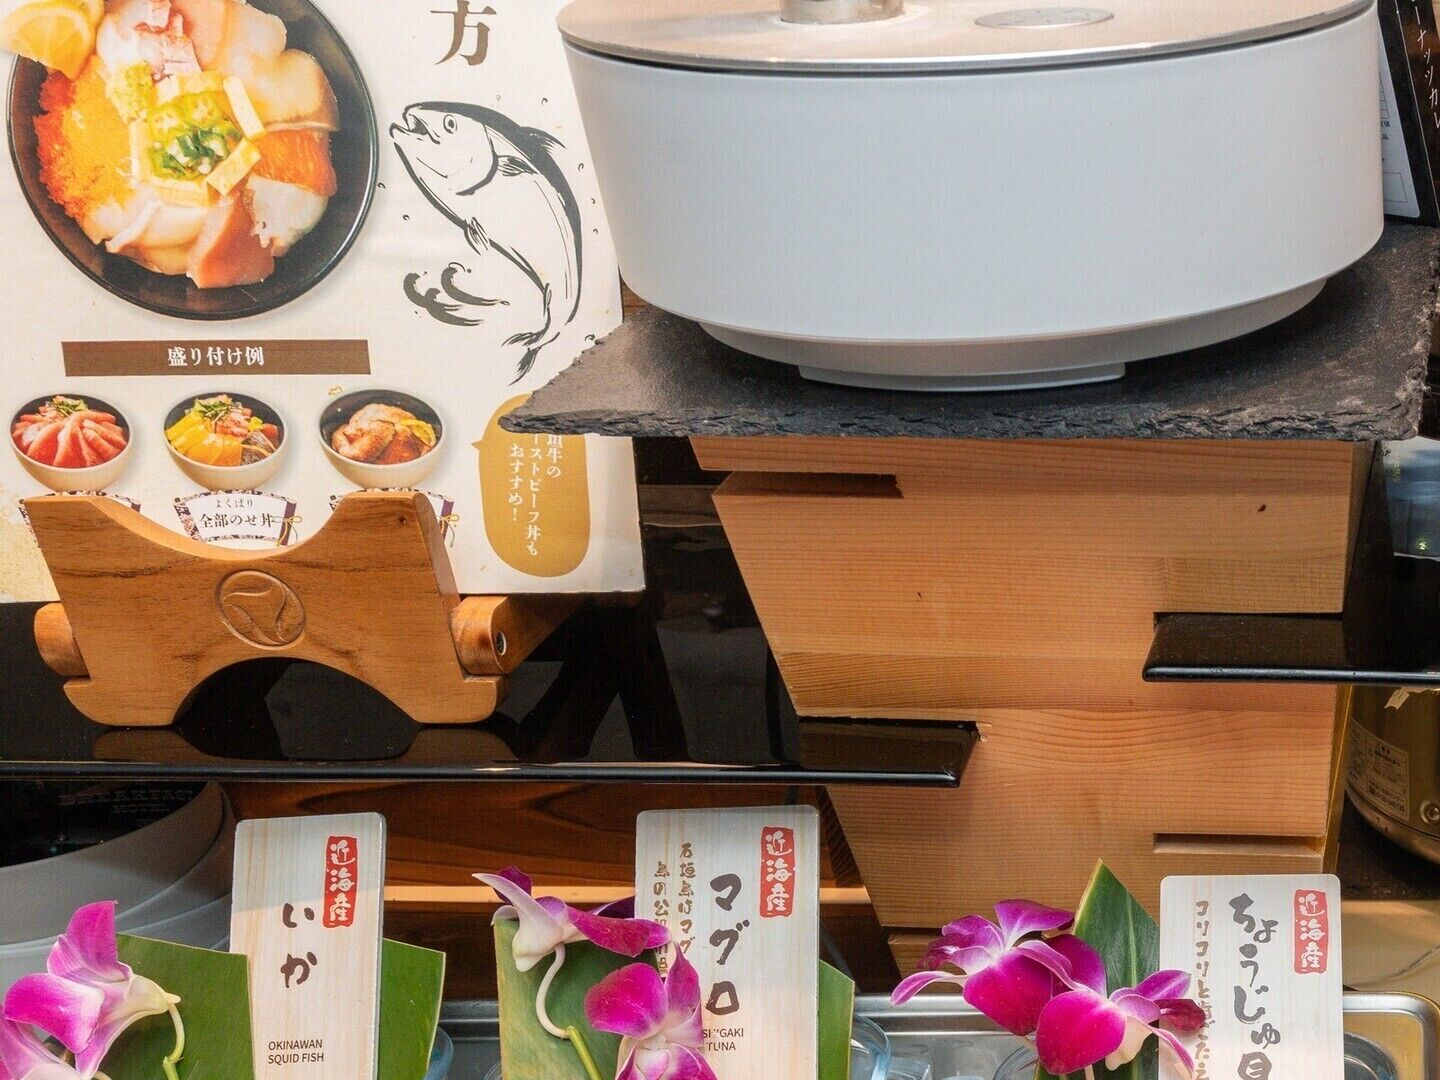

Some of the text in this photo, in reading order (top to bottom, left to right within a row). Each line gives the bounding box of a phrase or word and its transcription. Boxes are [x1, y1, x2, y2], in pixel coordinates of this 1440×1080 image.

[430, 0, 497, 66] 方
[167, 346, 264, 366] 盛り付け例
[508, 444, 524, 521] おすすめ！
[199, 513, 273, 529] 全部のせ丼
[330, 839, 356, 922] 近海産
[764, 830, 793, 912] 近海産
[280, 902, 318, 989] いか
[706, 873, 751, 1016] マグロ
[1298, 893, 1325, 968] 近海産
[267, 1053, 324, 1066] SQUID FISH
[268, 1039, 323, 1051] OKINAWAN
[706, 1042, 736, 1051] TUNA
